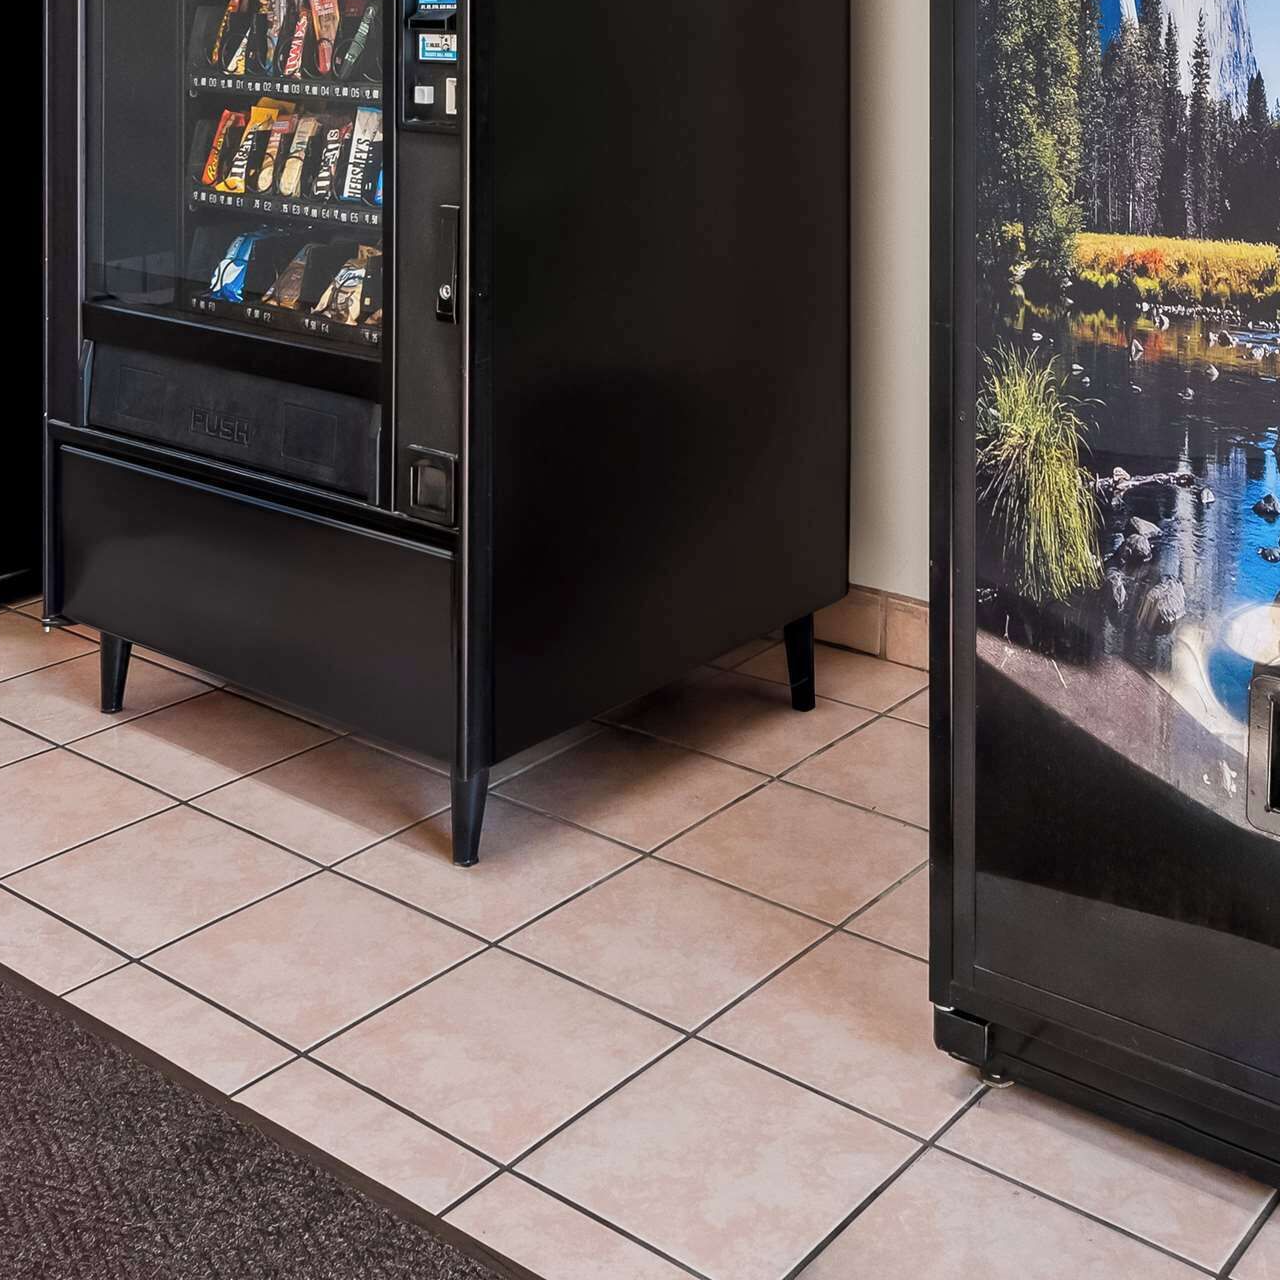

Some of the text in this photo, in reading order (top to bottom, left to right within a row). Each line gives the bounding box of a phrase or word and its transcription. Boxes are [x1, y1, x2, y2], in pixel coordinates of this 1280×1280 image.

[236, 197, 244, 207] E1
[263, 201, 272, 211] E2
[291, 204, 300, 215] E3
[321, 208, 330, 219] E4
[350, 212, 359, 223] E5
[190, 407, 249, 447] PUSH
